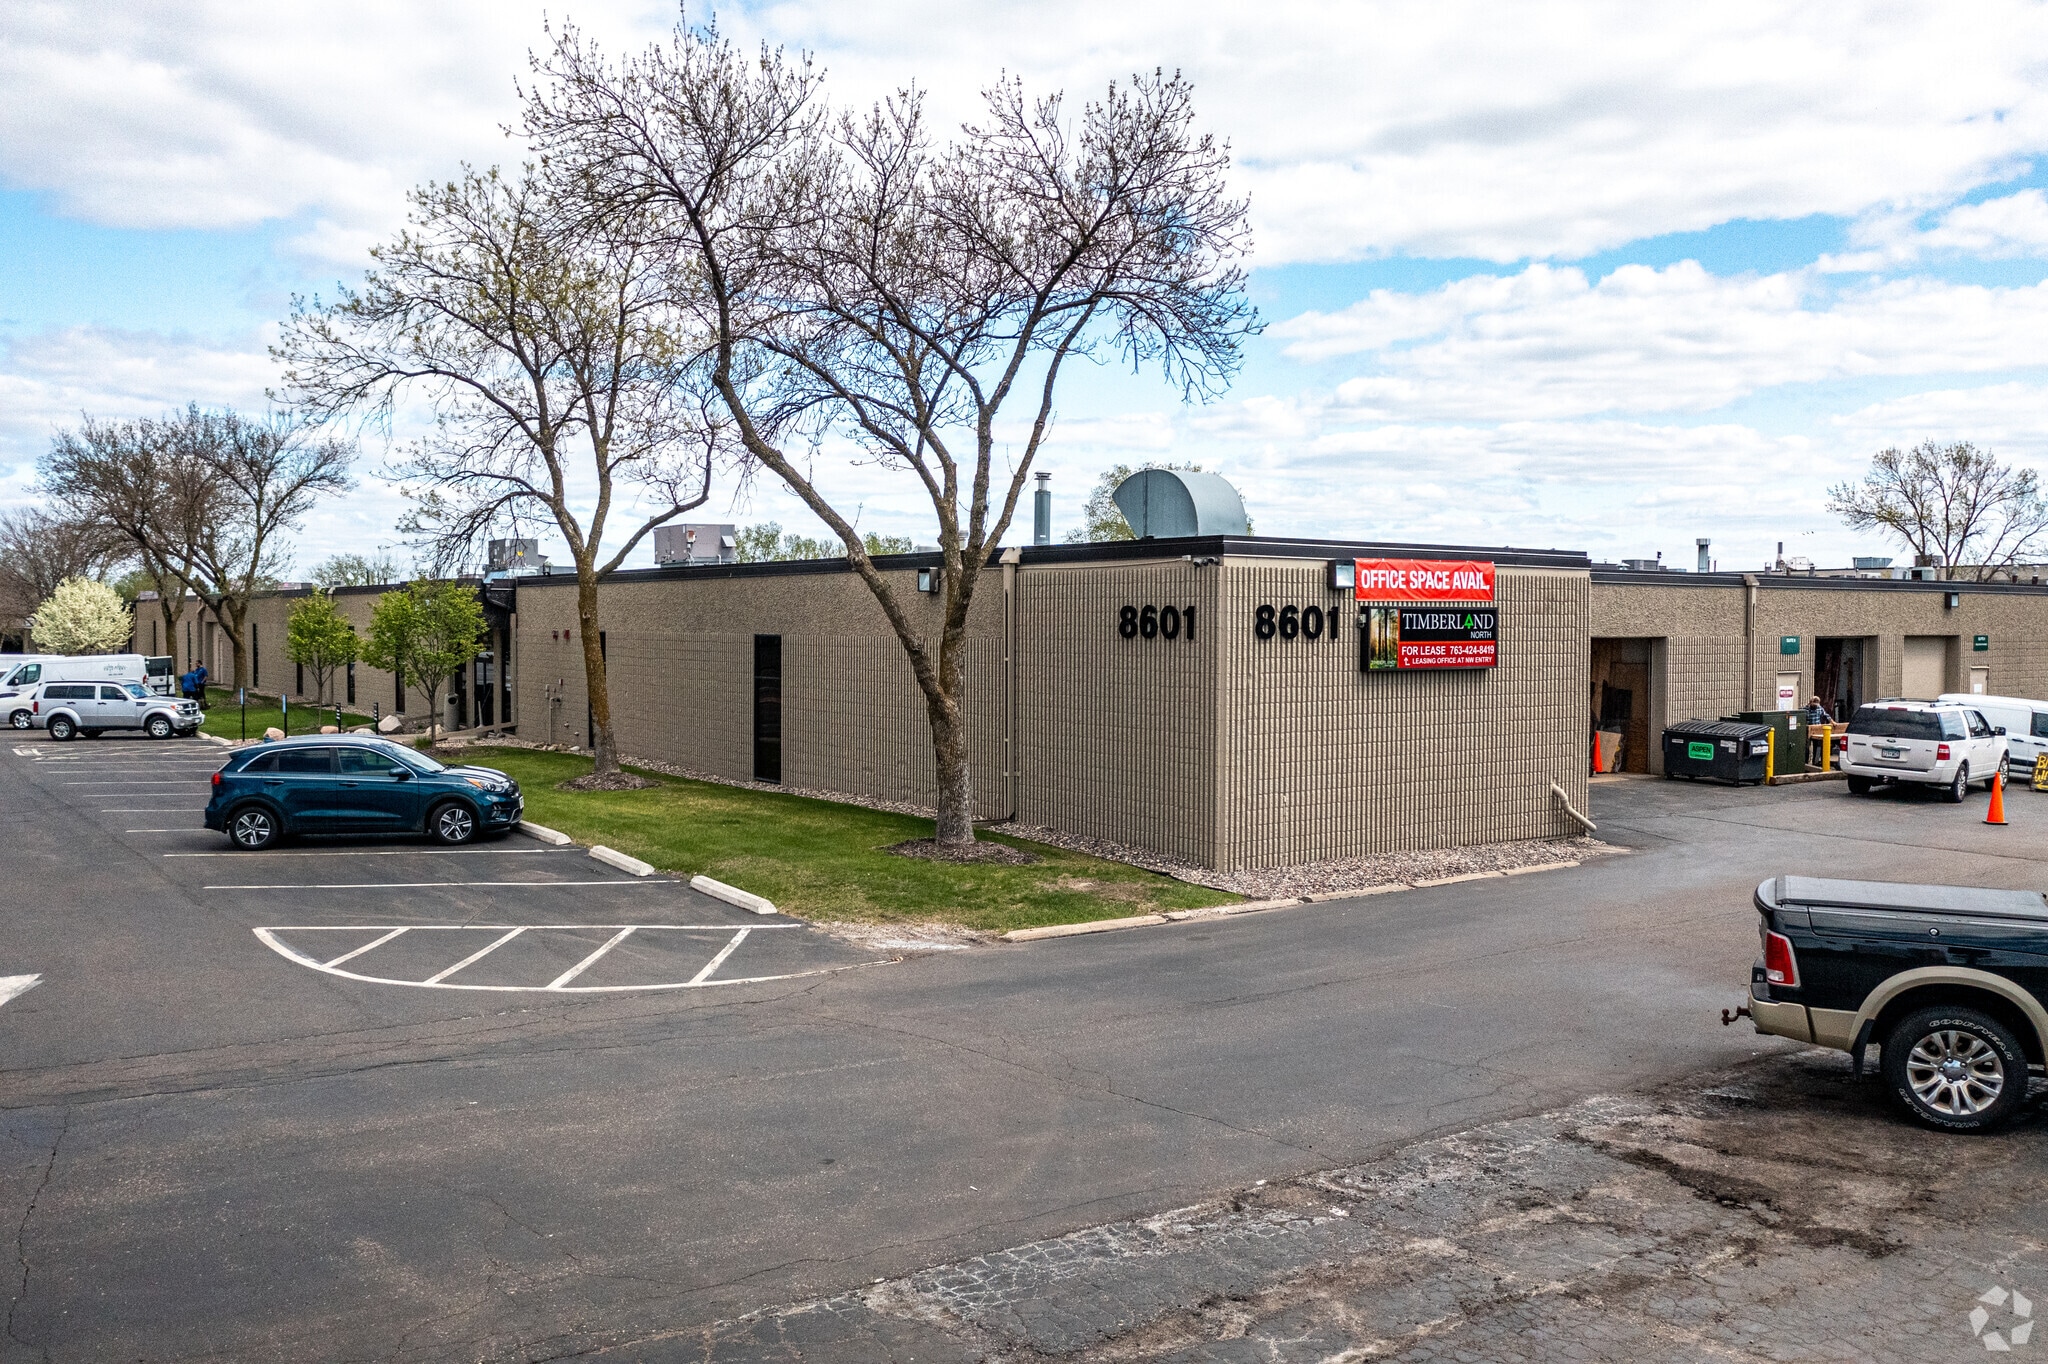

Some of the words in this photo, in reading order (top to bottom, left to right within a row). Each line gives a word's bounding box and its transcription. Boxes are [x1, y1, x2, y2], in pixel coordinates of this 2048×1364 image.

[1361, 569, 1406, 589] OFFICE
[1409, 570, 1450, 589] SPACE
[1452, 571, 1490, 590] AVAIL.
[1119, 605, 1195, 640] 8601
[1255, 605, 1339, 640] 8601
[1402, 613, 1494, 630] TIMBERLAND
[1470, 631, 1492, 639] NORTH
[1401, 645, 1419, 656] FOR
[1420, 645, 1446, 656] LEASE
[1449, 645, 1495, 655] 763-424-8419
[1412, 657, 1437, 665] LEASING
[1436, 657, 1457, 665] OFFICE
[1456, 656, 1465, 664] AT
[1465, 656, 1475, 664] NW
[1474, 656, 1493, 664] ENTRY
[1691, 745, 1711, 753] ASPEN
[1928, 1018, 2014, 1061] GOODYEAR
